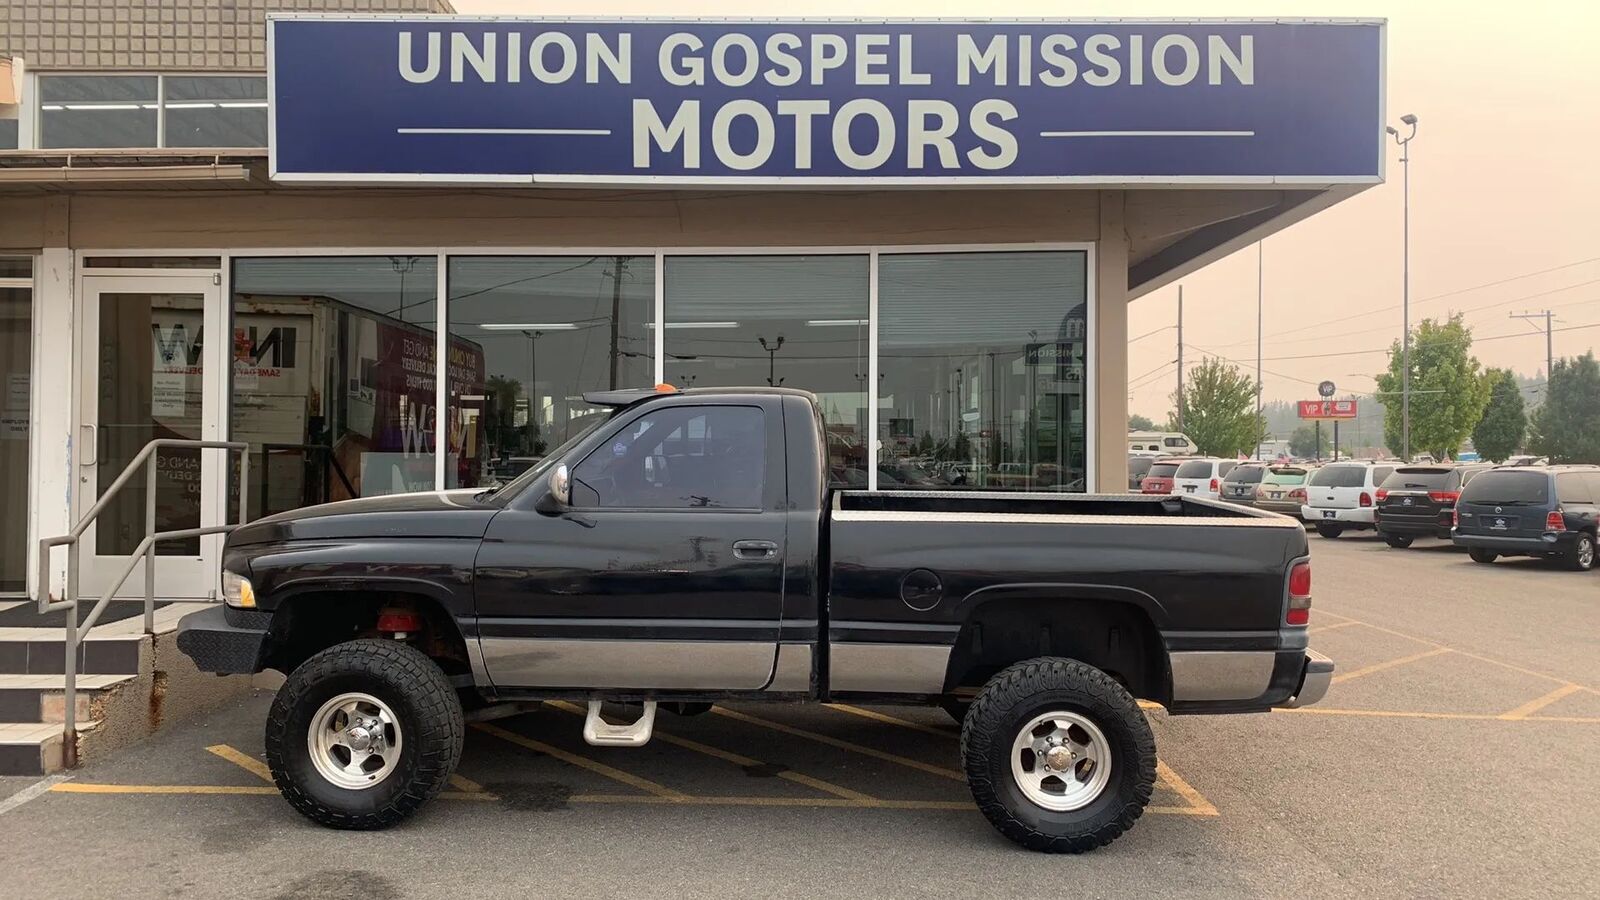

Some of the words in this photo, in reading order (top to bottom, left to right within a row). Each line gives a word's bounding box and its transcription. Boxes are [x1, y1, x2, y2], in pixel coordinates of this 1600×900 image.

[399, 32, 631, 84] UNION
[659, 33, 931, 87] GOSPEL
[957, 34, 1254, 87] MISSION
[632, 99, 1019, 170] MOTORS
[1305, 404, 1318, 415] VIP
